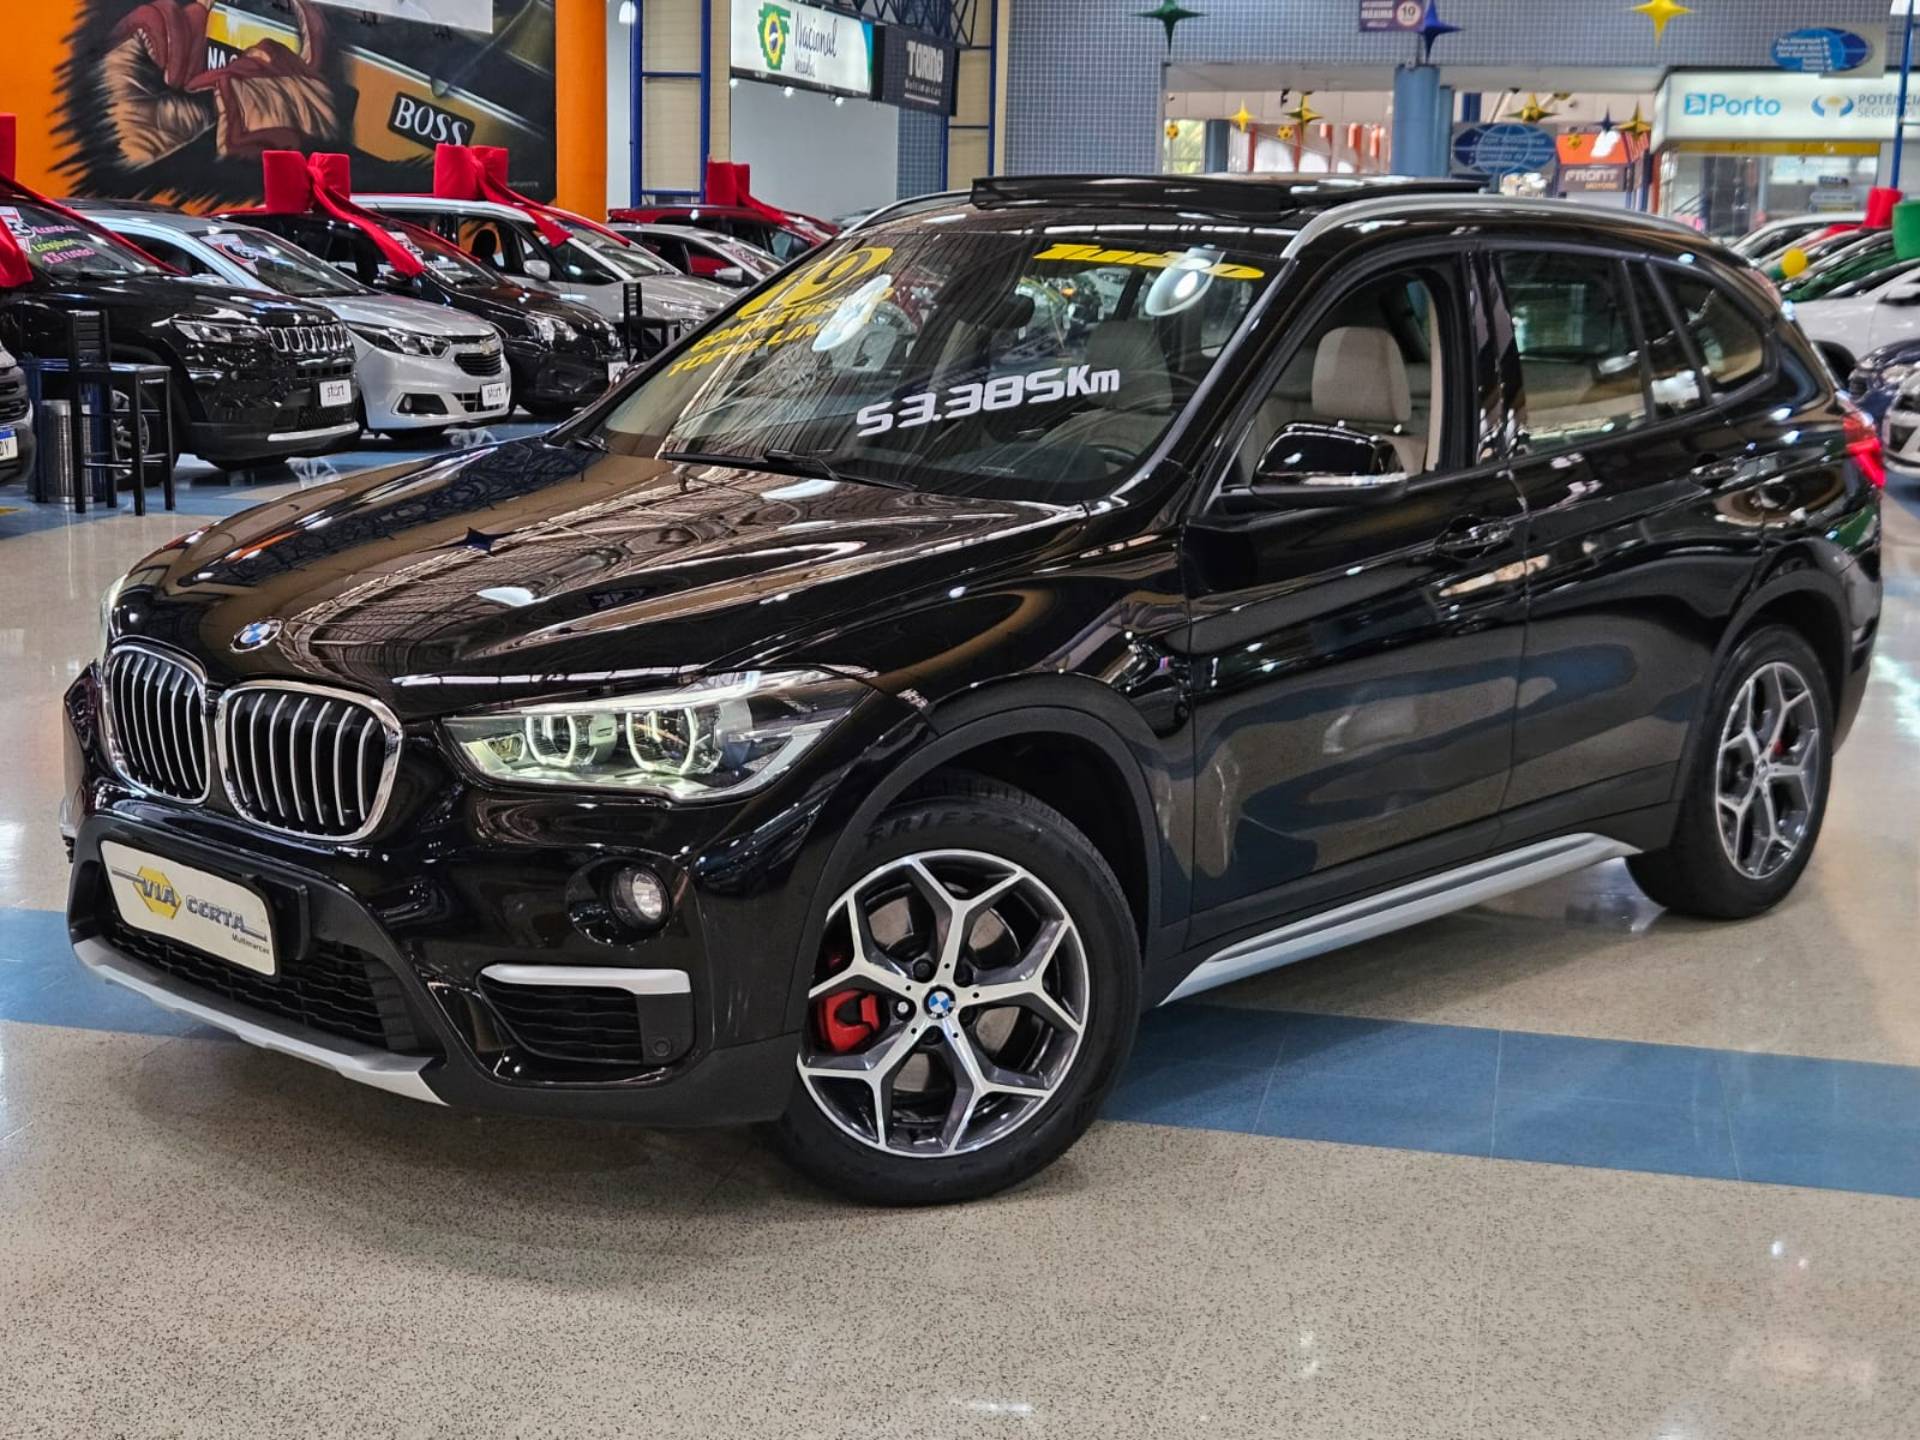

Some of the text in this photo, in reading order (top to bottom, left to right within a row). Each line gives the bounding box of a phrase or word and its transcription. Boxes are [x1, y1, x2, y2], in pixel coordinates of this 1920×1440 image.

[1401, 5, 1416, 17] 10
[794, 11, 838, 58] Nacional
[906, 40, 943, 83] TORINO
[394, 97, 468, 146] BOSS
[1709, 93, 1781, 115] Porto
[1565, 169, 1617, 181] FRONT
[142, 876, 248, 933] VIA CERTA
